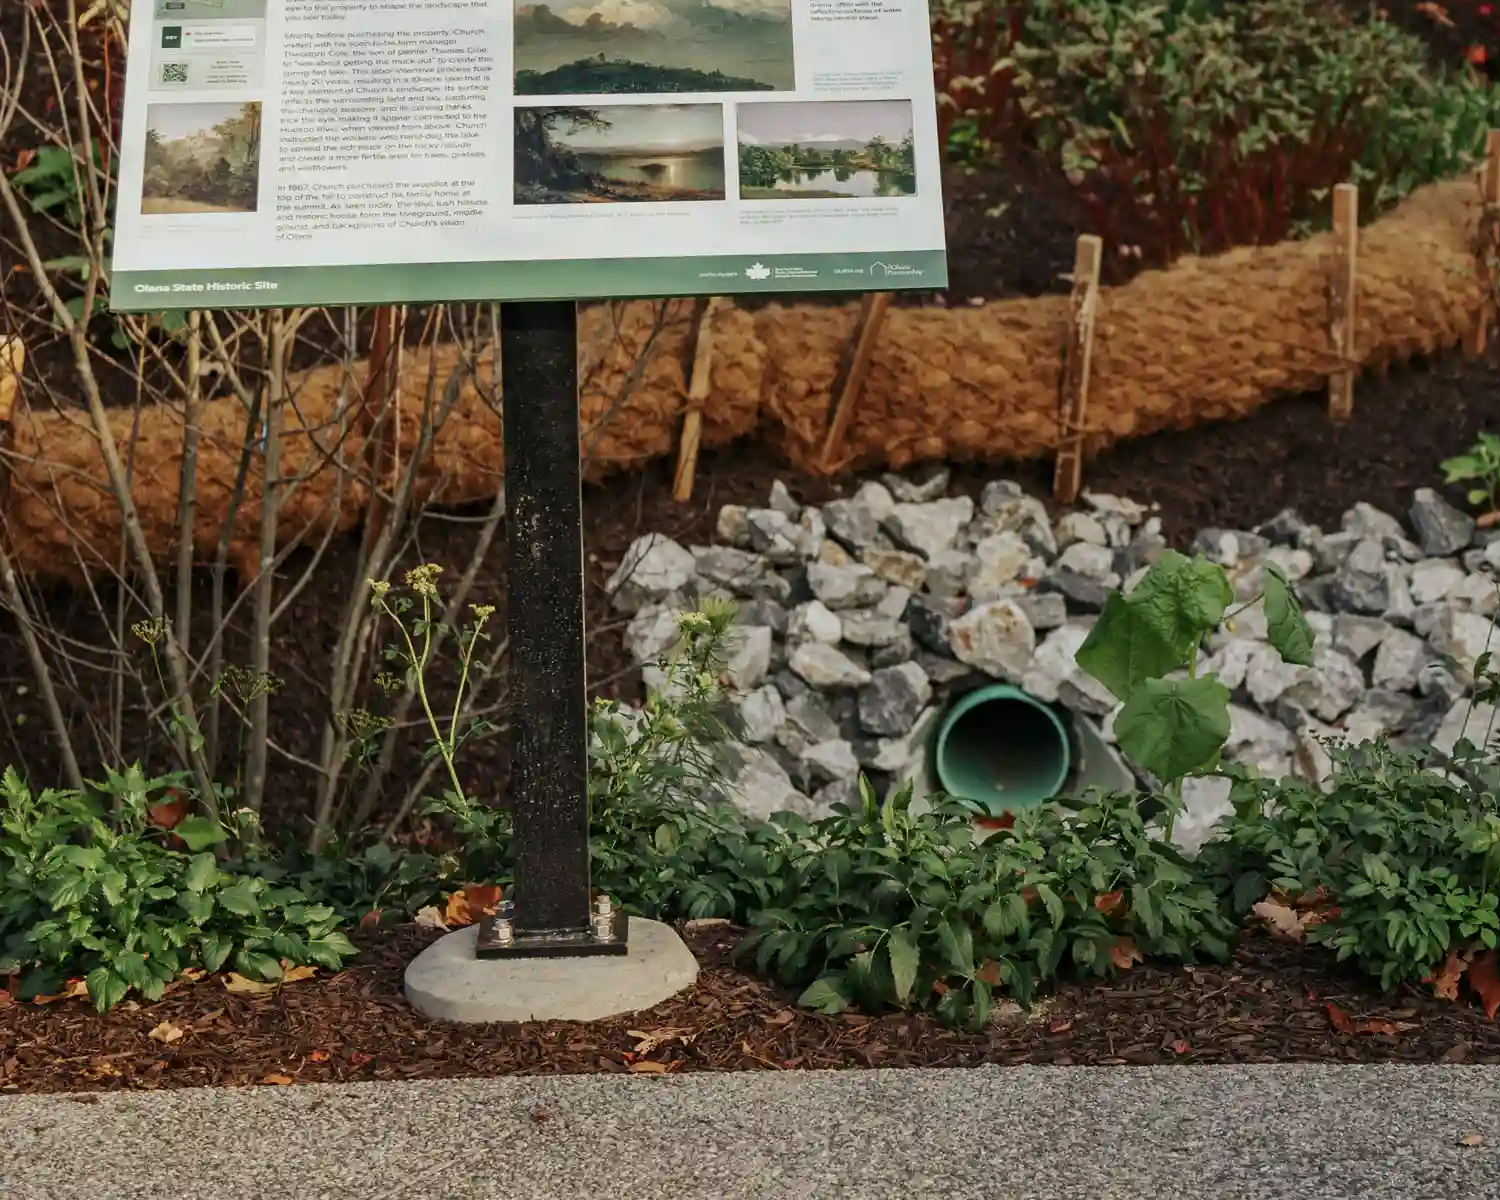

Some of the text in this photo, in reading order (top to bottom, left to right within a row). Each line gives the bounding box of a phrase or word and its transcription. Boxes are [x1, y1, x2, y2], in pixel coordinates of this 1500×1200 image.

[134, 281, 278, 292] Olana State Historic Site
